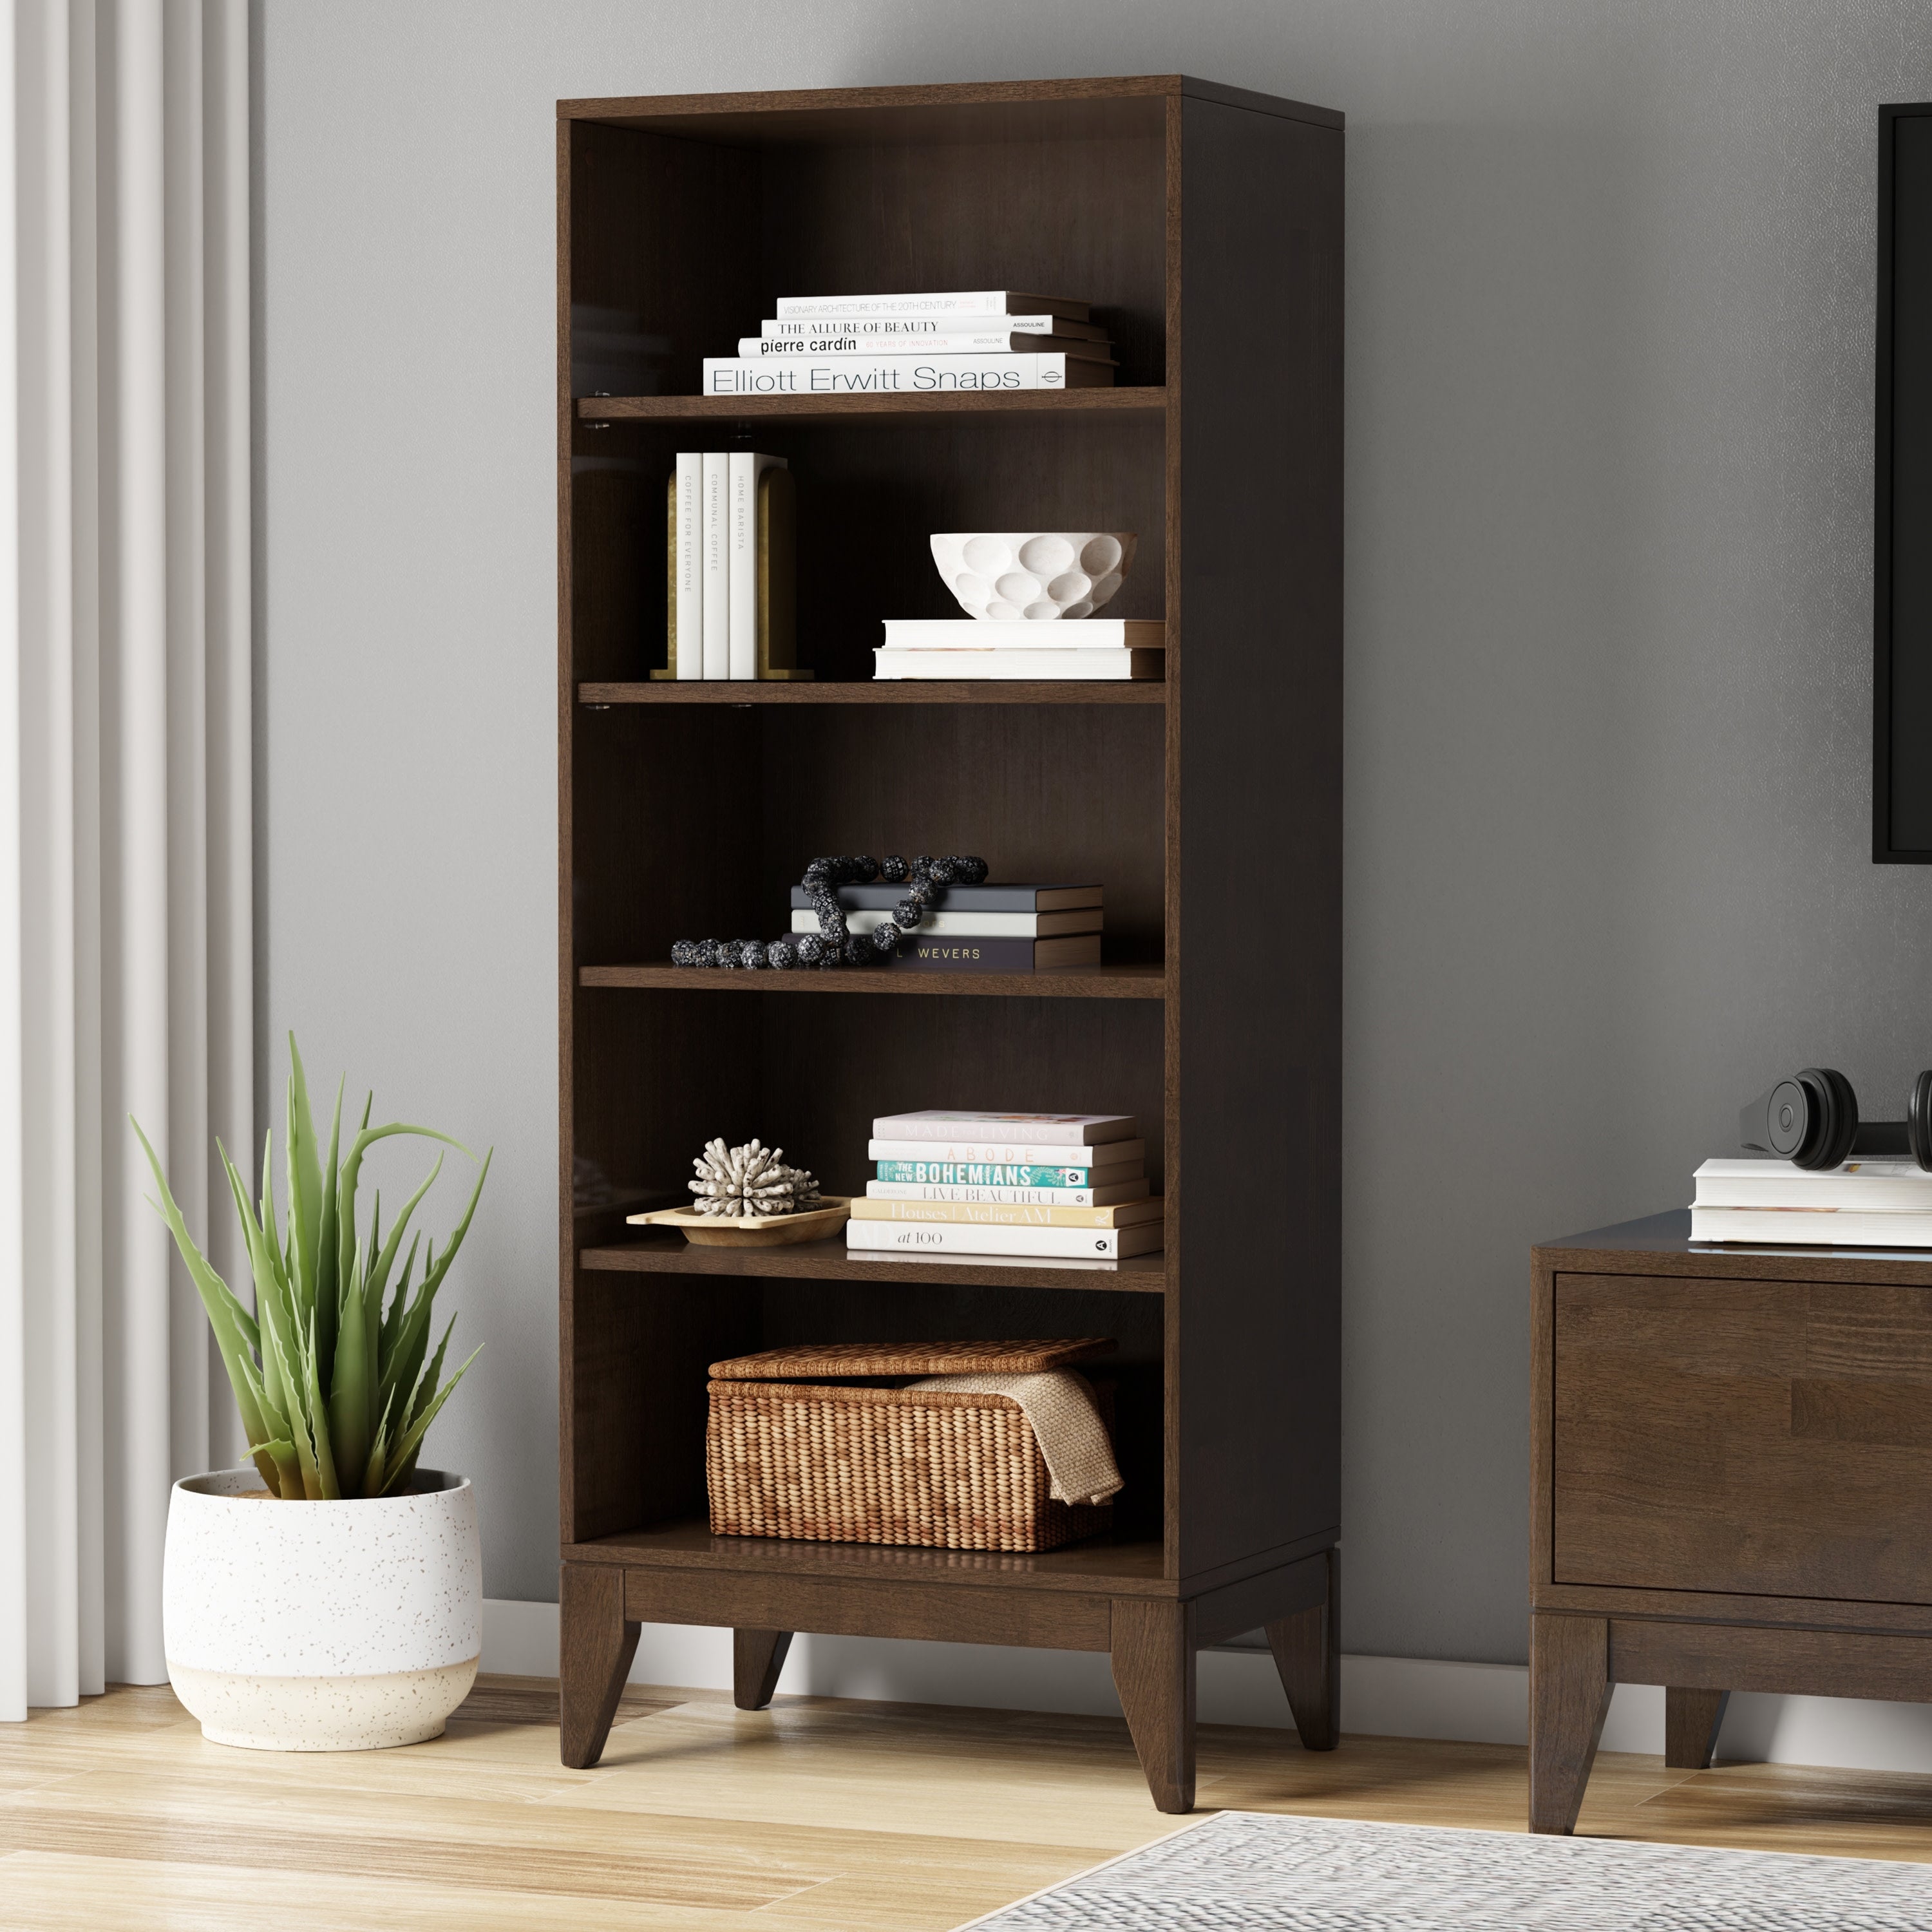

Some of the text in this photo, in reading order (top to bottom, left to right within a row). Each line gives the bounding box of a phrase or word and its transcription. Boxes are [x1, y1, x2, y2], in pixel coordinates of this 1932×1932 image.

[784, 305, 817, 314] VISIONARY
[818, 303, 870, 313] ARCHITECTURE
[871, 303, 882, 312] OF
[882, 302, 898, 311] THE
[898, 301, 918, 310] 20TH
[919, 300, 956, 310] CENTURY
[778, 321, 939, 334] THE ALLURE OF BEAUTY
[761, 337, 857, 355] pierre cardin
[714, 367, 1019, 392] Elliott Erwitt Snaps
[918, 948, 980, 959] WEVERS
[905, 1125, 959, 1138] MADE
[980, 1127, 1048, 1141] LIVING
[947, 1148, 1034, 1163] ABODE
[897, 1162, 913, 1172] THE
[916, 1162, 1030, 1186] BOHEMIANS
[895, 1173, 913, 1181] NEW
[923, 1187, 1061, 1204] LIVE BEAUTIFUL
[891, 1203, 947, 1220] Houses
[962, 1206, 1016, 1223] Atelier
[1019, 1208, 1052, 1223] AM
[898, 1233, 911, 1244] at
[915, 1232, 942, 1245] 100
